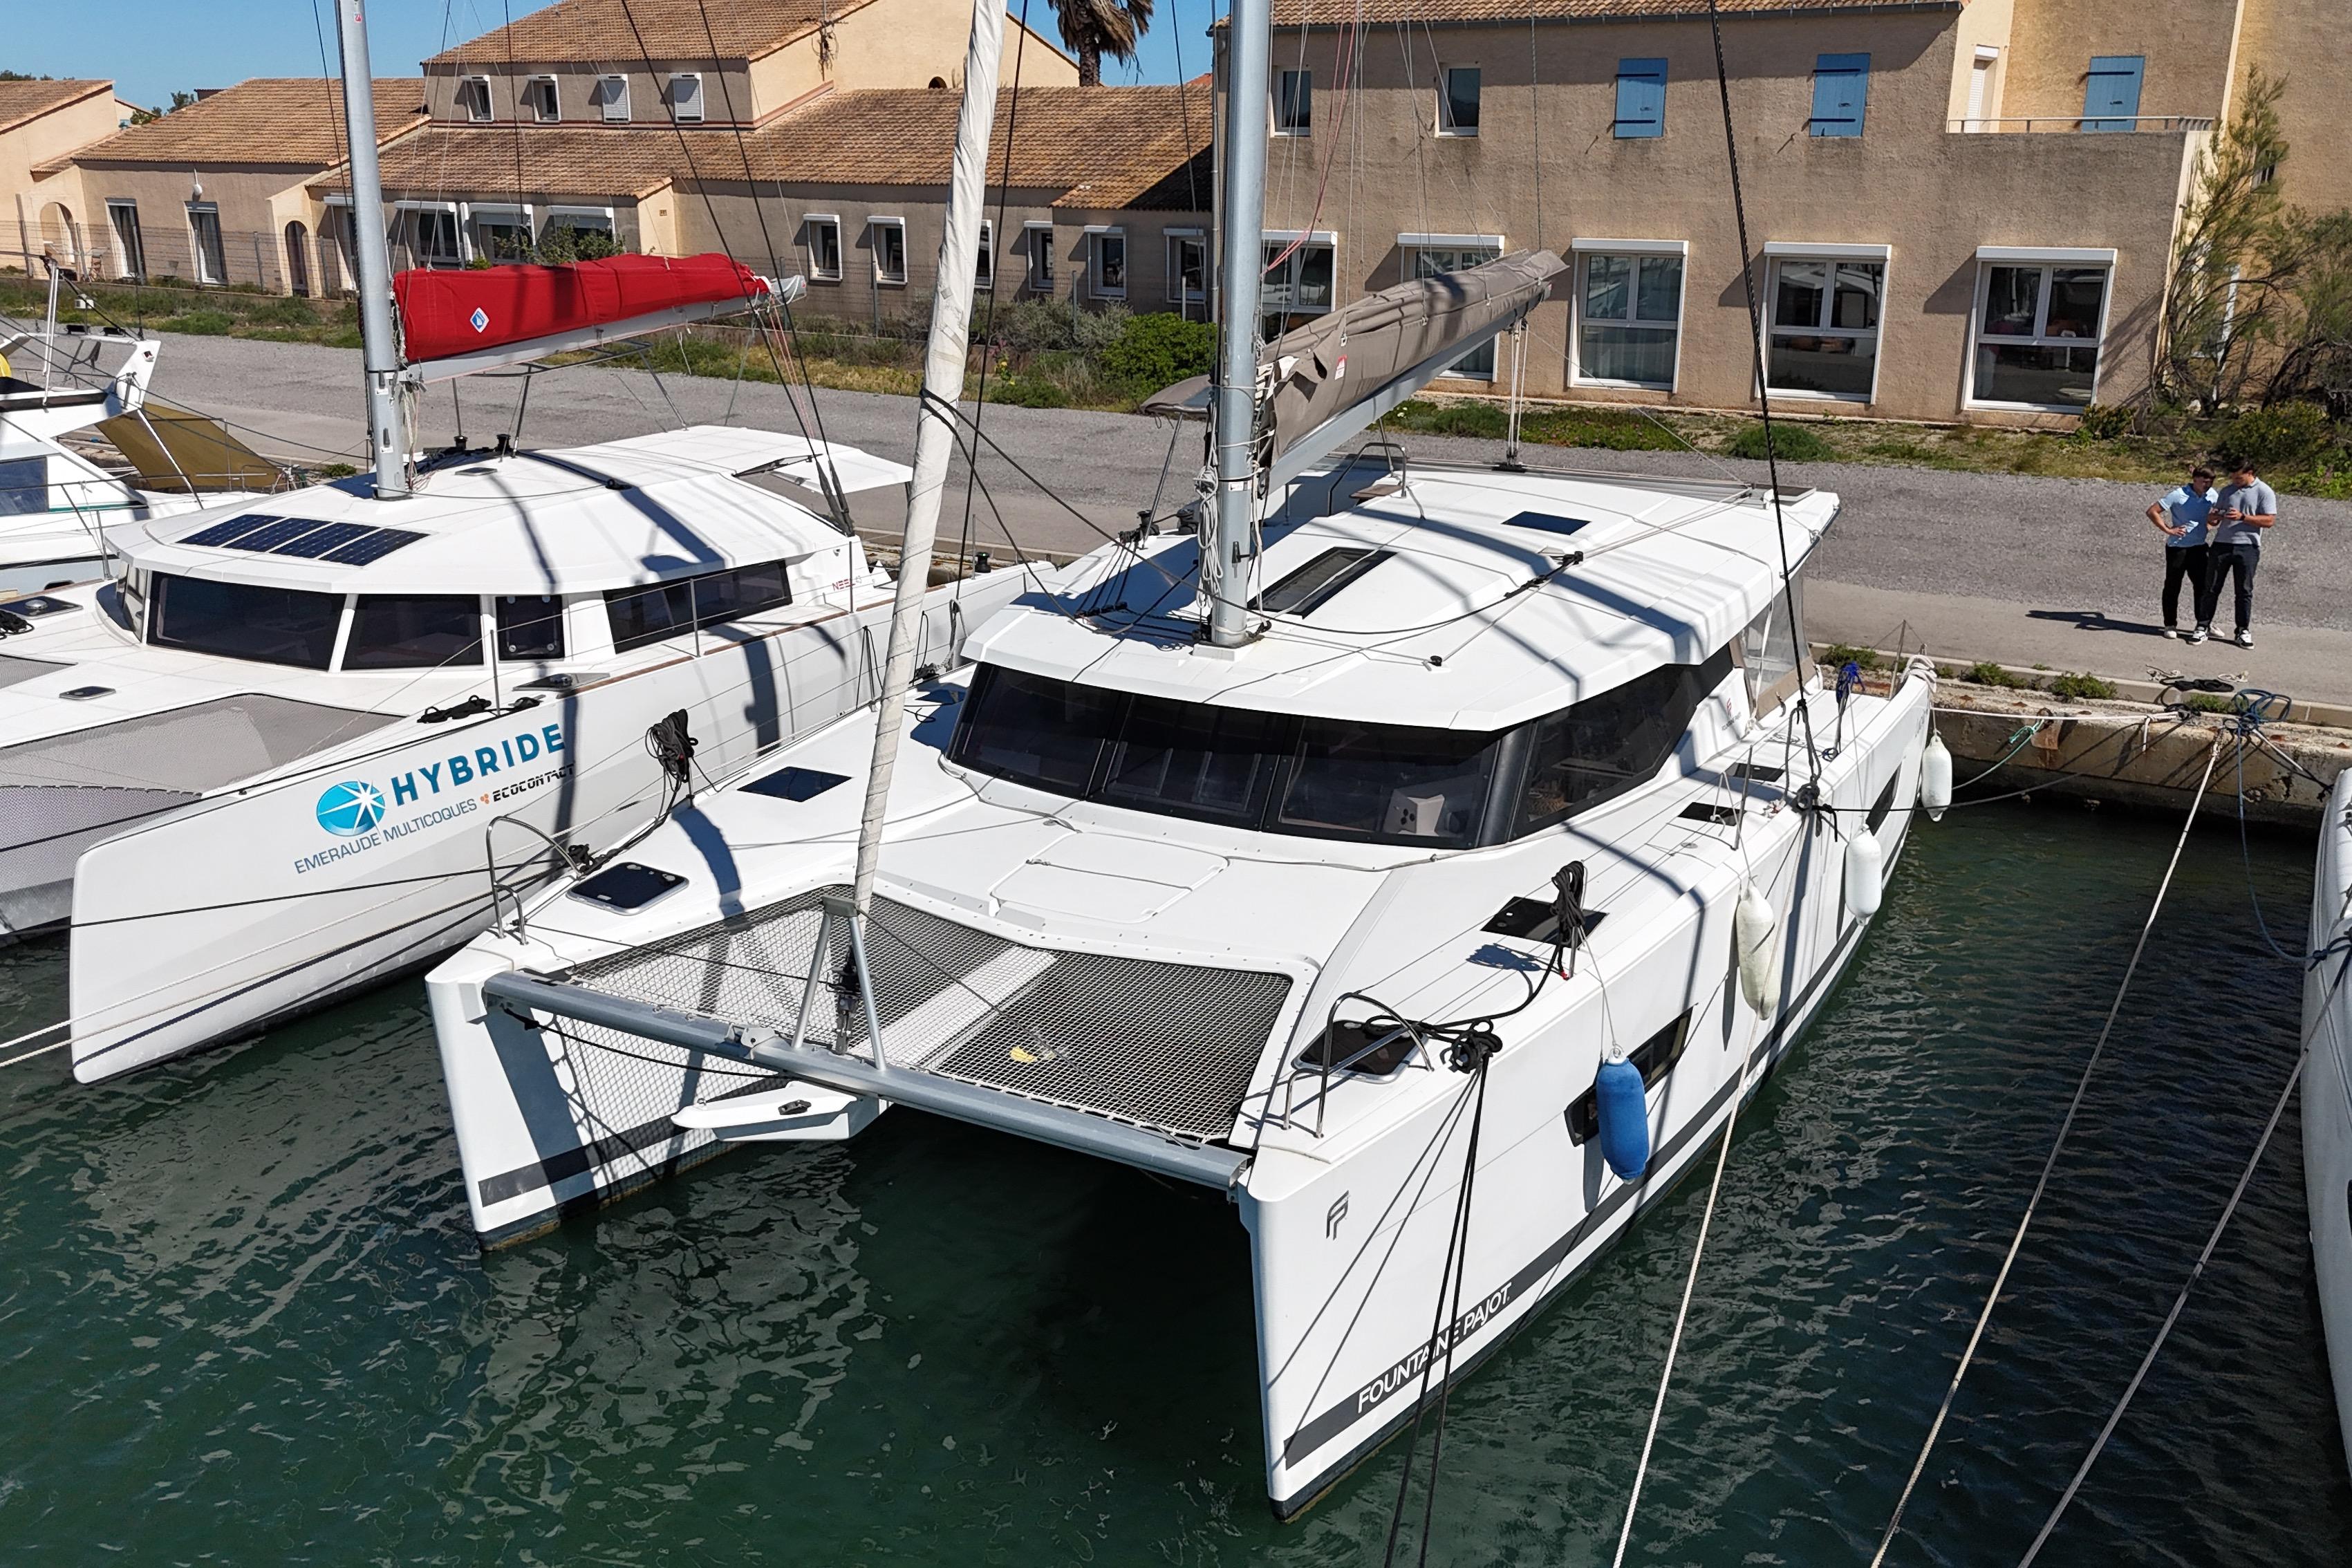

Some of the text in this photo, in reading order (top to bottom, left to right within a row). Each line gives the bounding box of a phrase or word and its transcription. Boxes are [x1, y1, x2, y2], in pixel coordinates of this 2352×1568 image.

[391, 723, 566, 806] HYBRIDE
[492, 763, 575, 802] ECOCONTACT
[294, 798, 477, 874] EMERAUDE MULTICOQUES
[1357, 1282, 1512, 1413] FOUNTANE PAJOT
